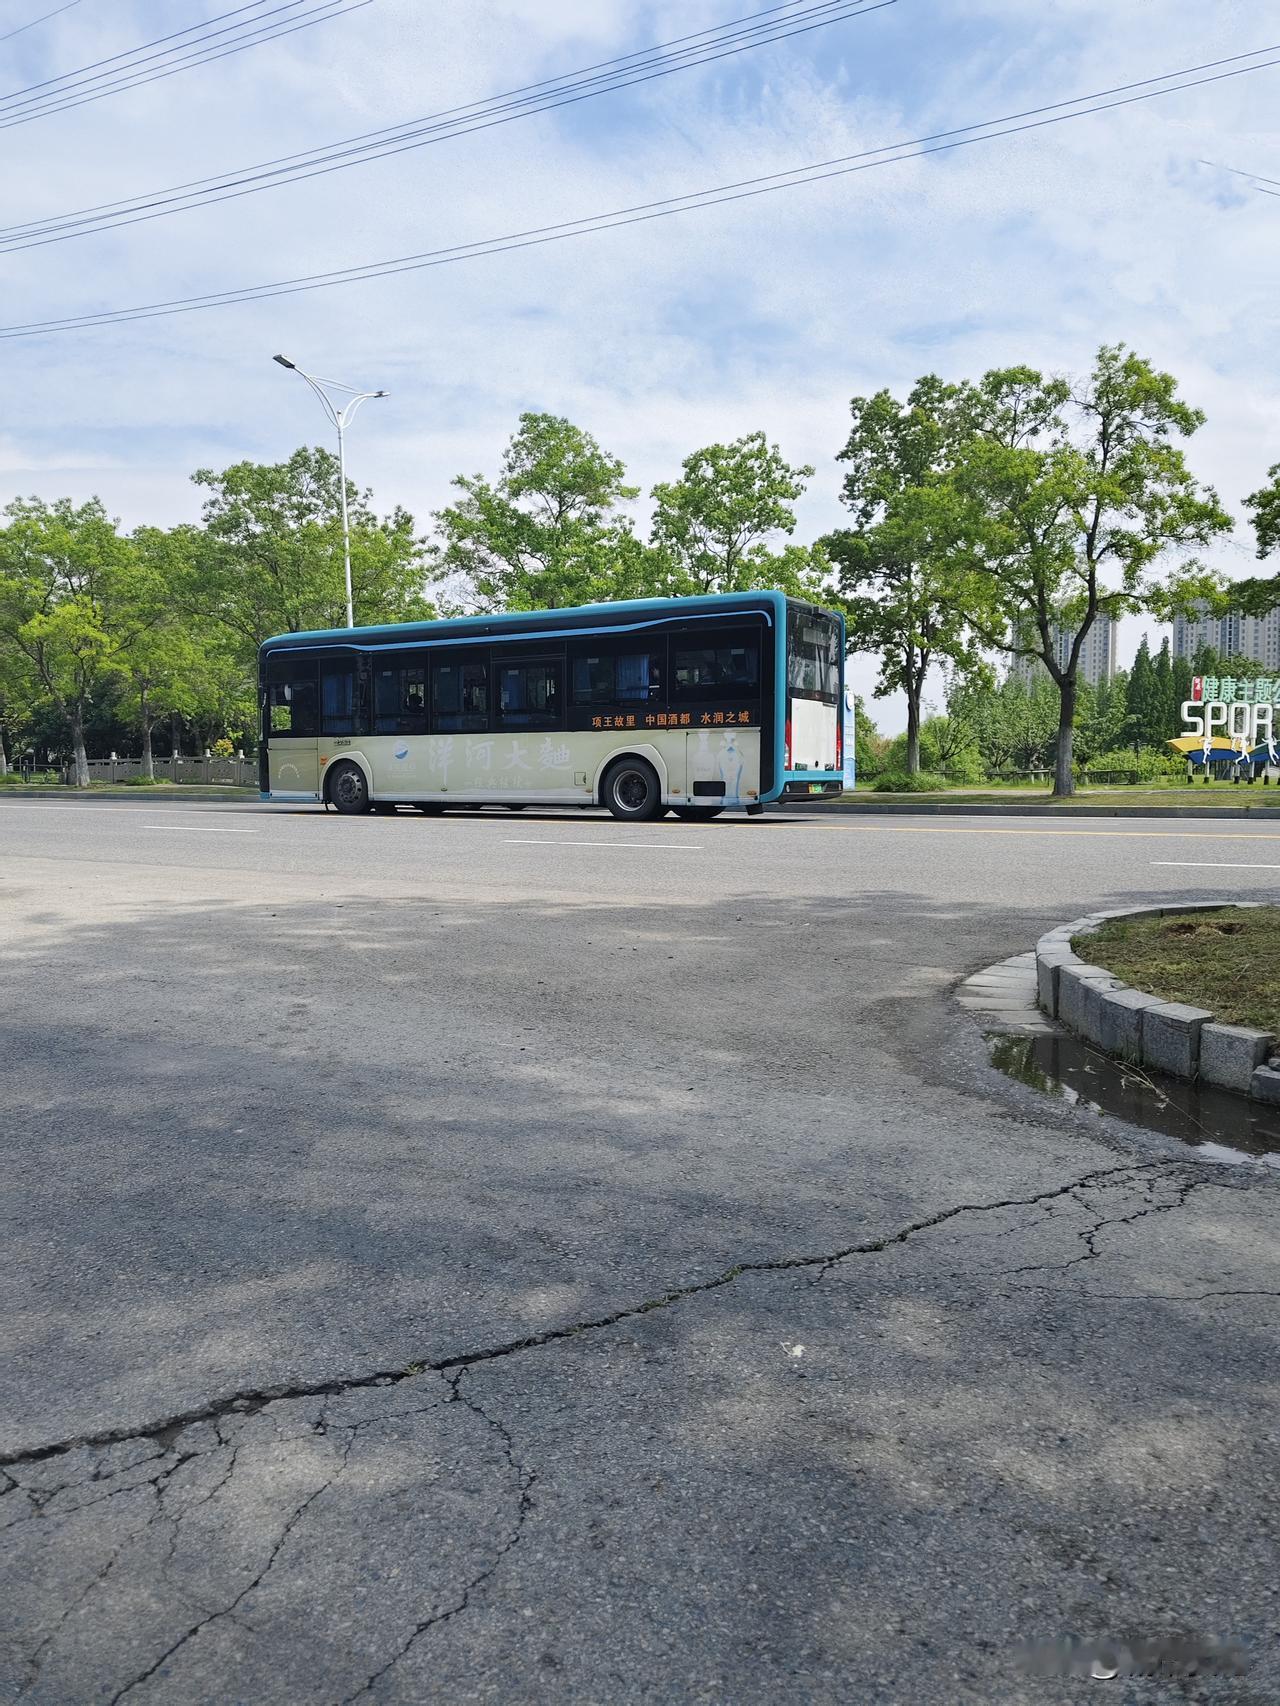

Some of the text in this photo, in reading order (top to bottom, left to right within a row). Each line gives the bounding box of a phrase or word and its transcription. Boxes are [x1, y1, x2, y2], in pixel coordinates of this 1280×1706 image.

[591, 710, 750, 728] 项王故里 中国酒都 水润之城
